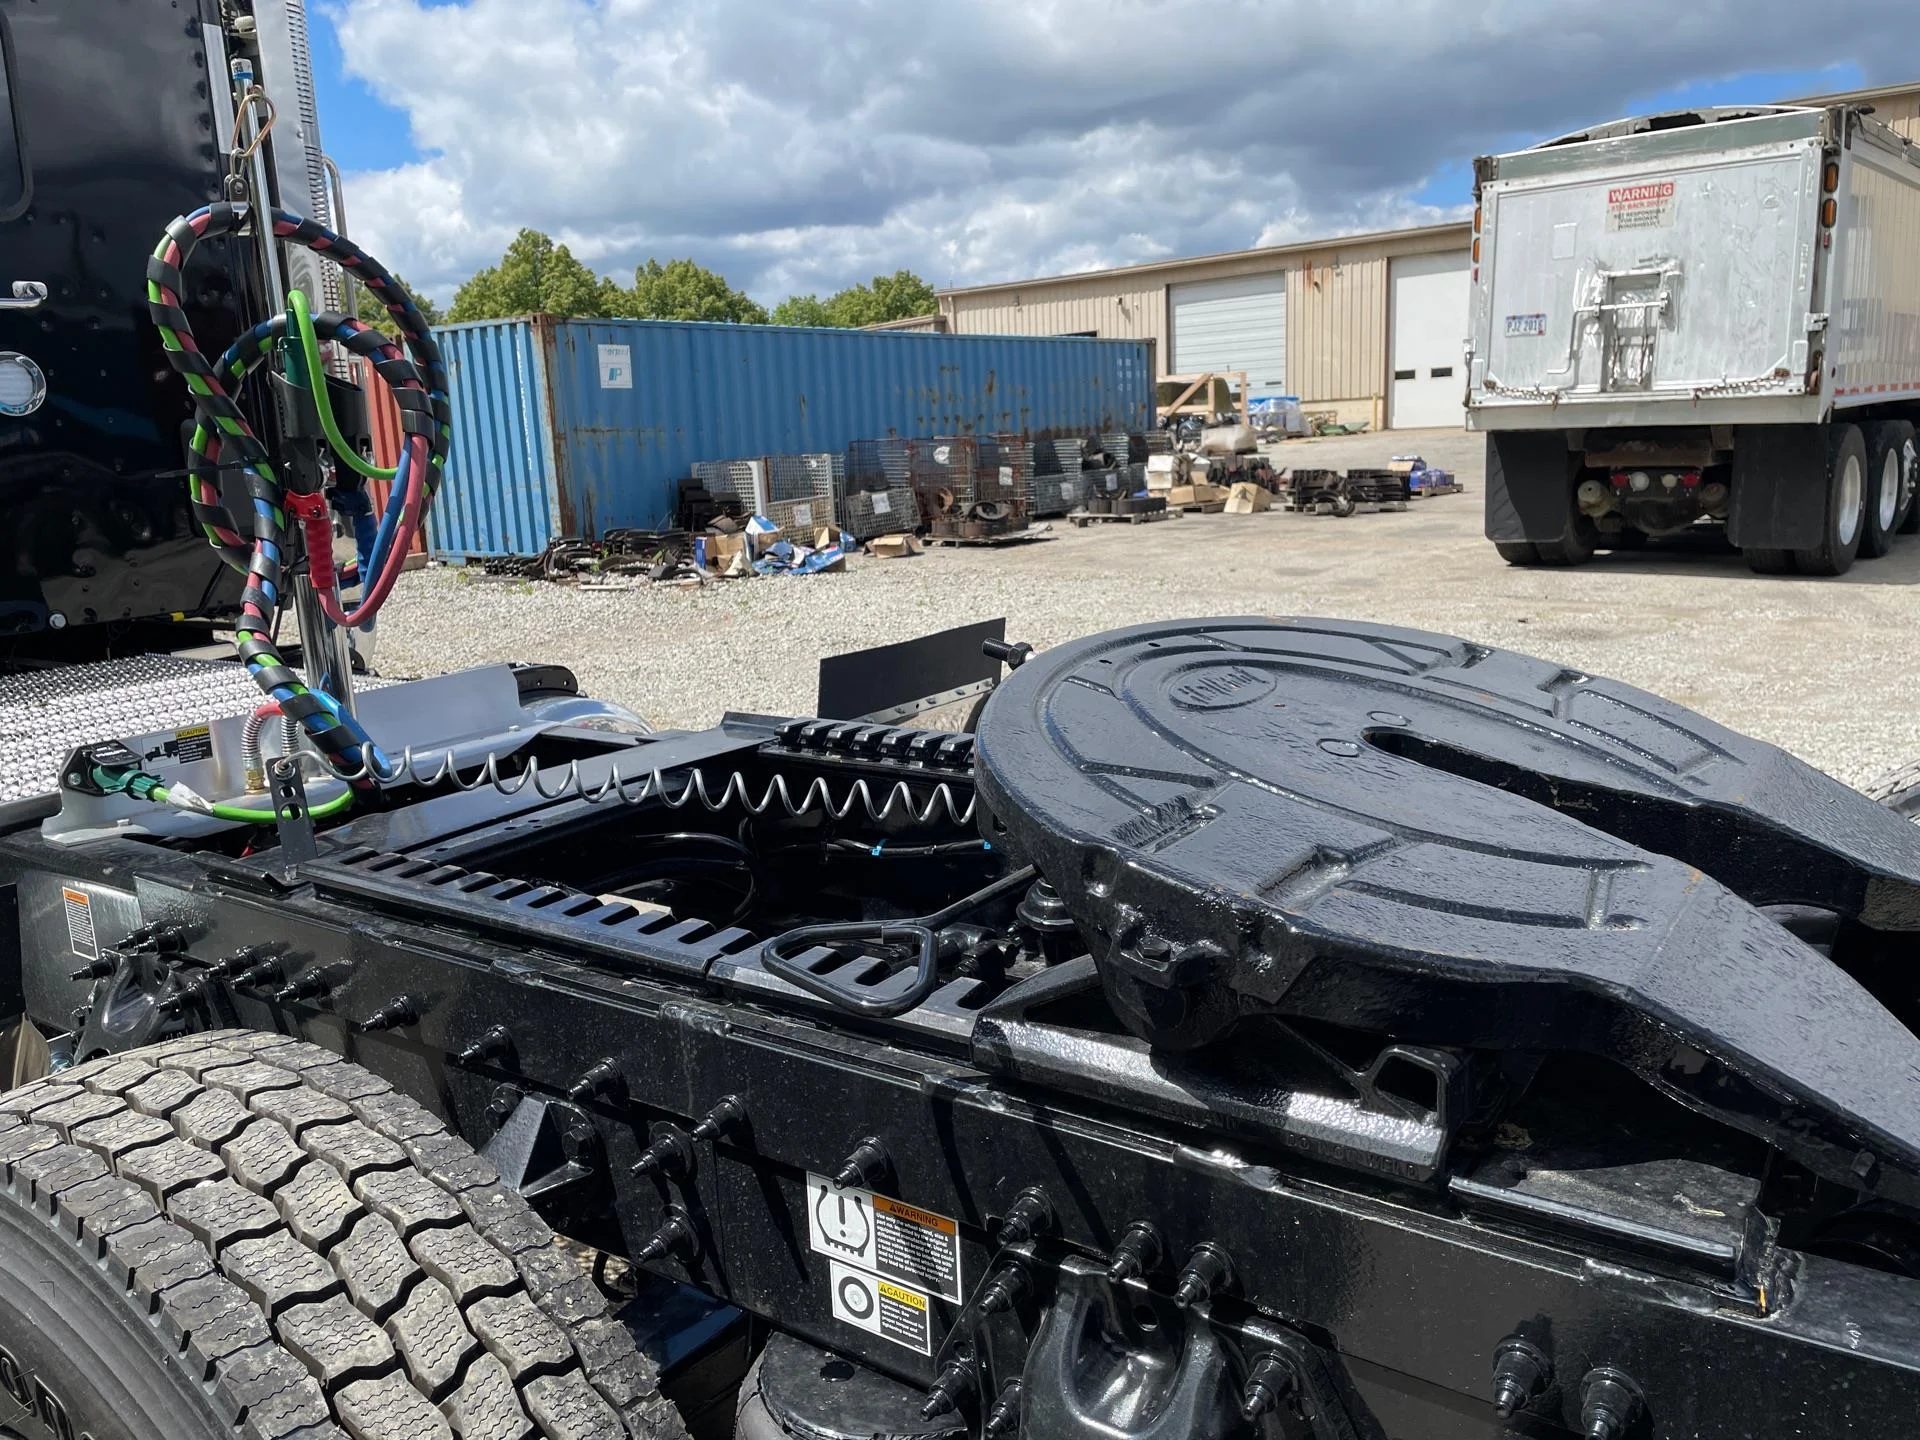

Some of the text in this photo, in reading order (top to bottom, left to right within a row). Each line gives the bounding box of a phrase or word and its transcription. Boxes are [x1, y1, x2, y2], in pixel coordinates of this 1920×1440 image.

[1611, 184, 1672, 202] WARNING
[181, 728, 208, 737] CAUTION
[896, 1206, 938, 1227] WARNING
[888, 1287, 925, 1308] CAUTION
